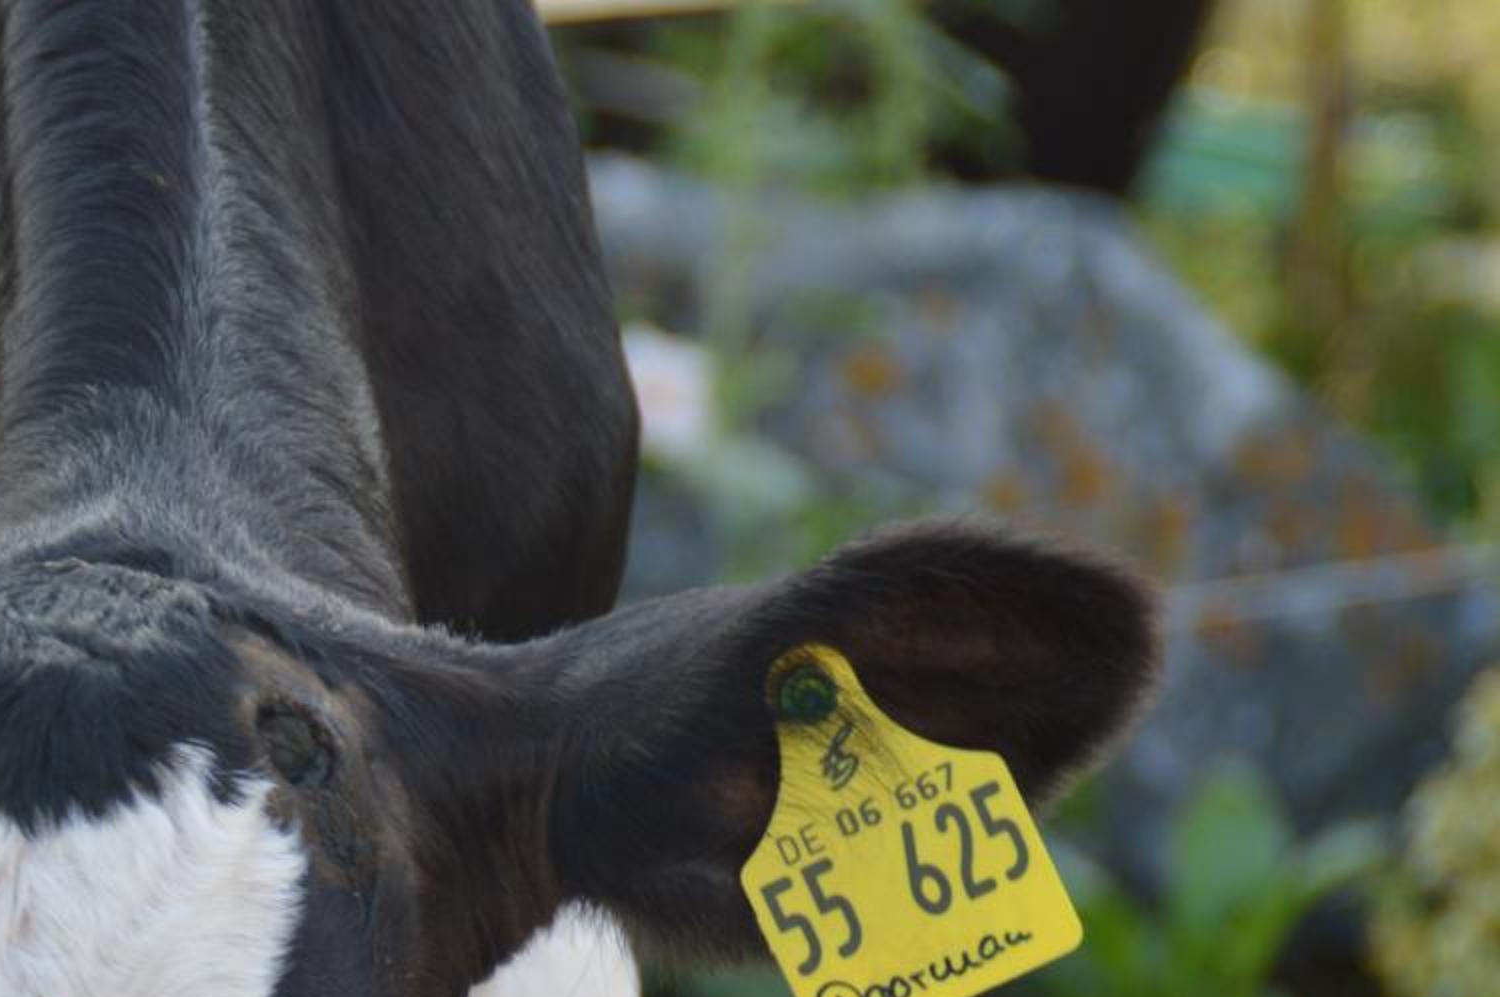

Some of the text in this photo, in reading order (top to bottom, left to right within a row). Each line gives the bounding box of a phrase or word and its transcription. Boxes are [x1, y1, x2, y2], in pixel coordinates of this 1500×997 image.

[760, 781, 1030, 977] 55 625
[775, 762, 955, 866] DE 06 667
